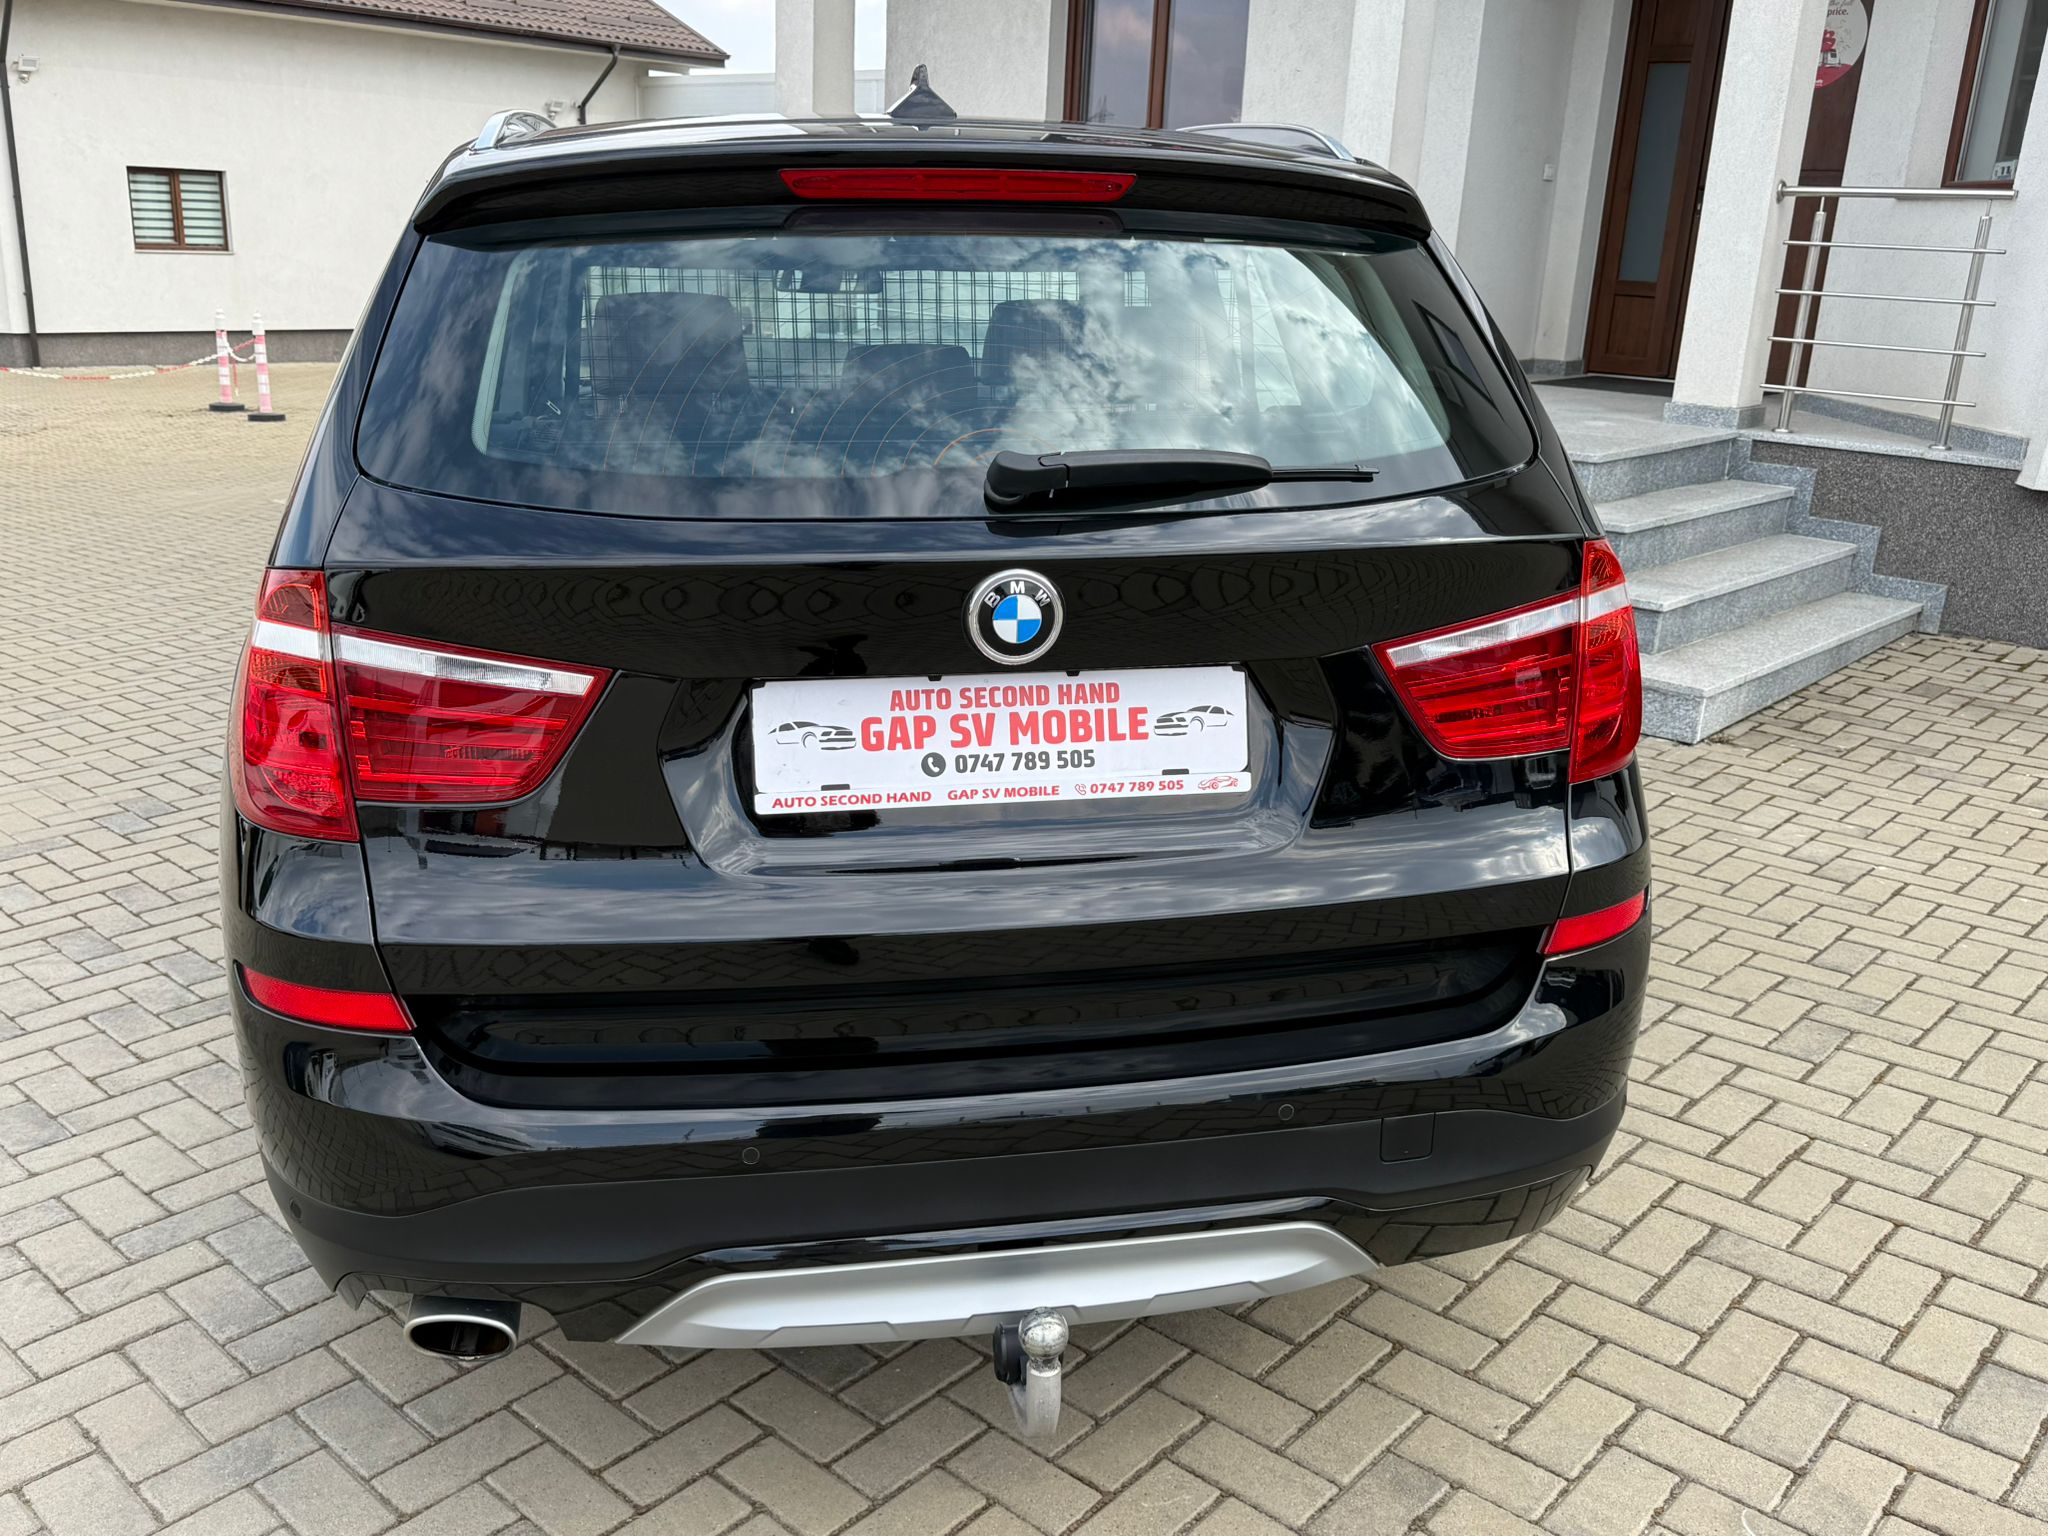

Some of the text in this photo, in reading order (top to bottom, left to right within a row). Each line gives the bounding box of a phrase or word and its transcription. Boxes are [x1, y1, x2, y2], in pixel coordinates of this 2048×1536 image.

[1826, 8, 1849, 18] price.
[984, 580, 1051, 609] BMW
[890, 682, 1121, 712] AUTO SECOND HAND
[860, 706, 1150, 752] GAP SV MOBILE
[954, 749, 1096, 774] 0747 789 505
[772, 779, 1185, 809] AUTO SECOND HAND GAP SV MOBILE 0747 789 505
